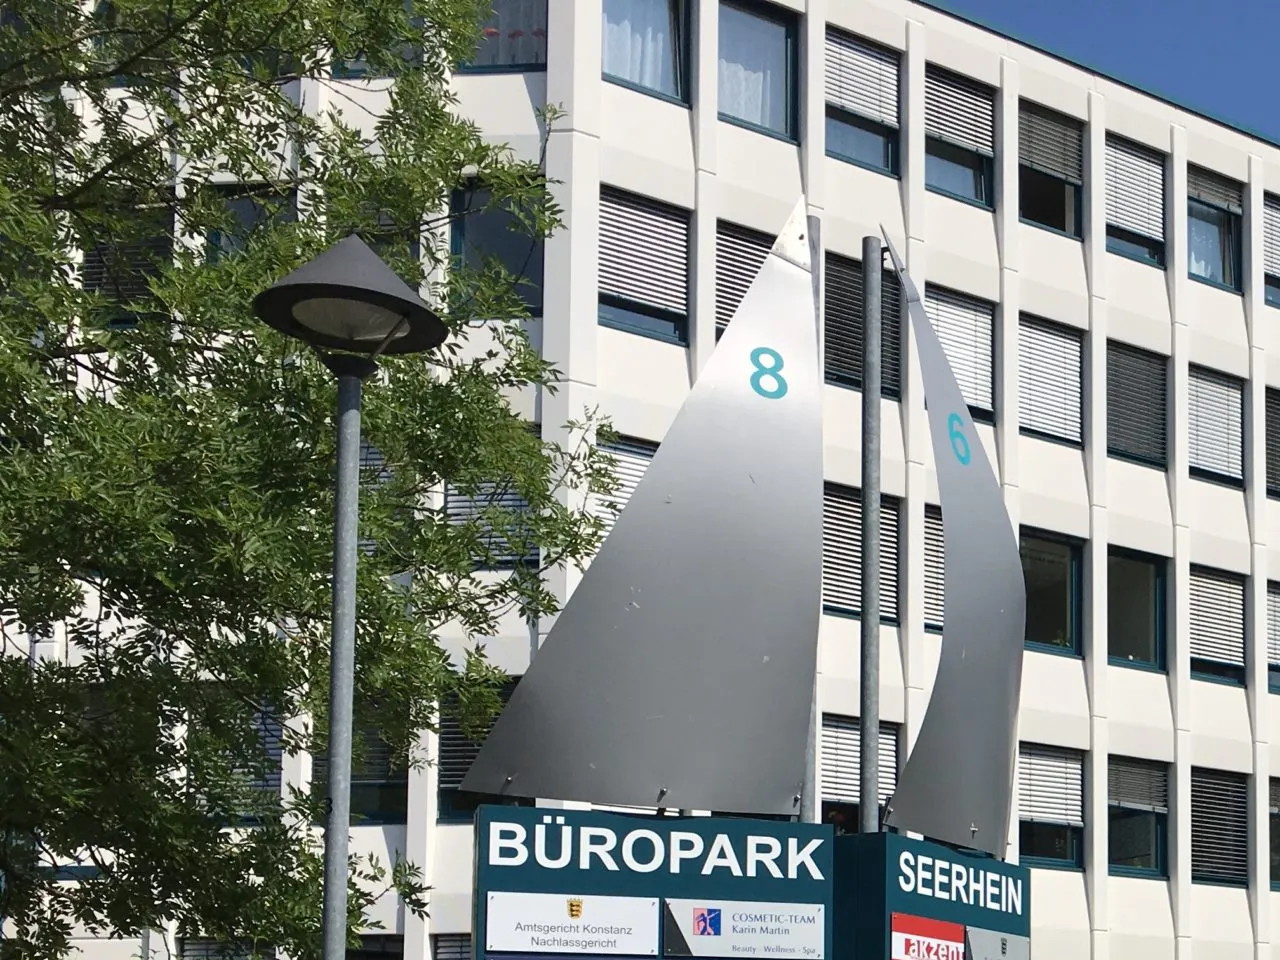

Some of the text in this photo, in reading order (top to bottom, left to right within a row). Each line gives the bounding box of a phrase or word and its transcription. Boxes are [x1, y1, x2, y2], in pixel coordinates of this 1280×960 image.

[749, 346, 789, 400] 8
[947, 412, 972, 466] 6
[488, 815, 825, 880] BÜROPARK
[898, 850, 1023, 916] SEERHEIN
[514, 922, 633, 936] Amtsgericht Konstanz
[732, 912, 816, 925] COSMETIC-TEAM
[732, 925, 757, 934] Karin
[530, 936, 617, 949] Nachlassgericht
